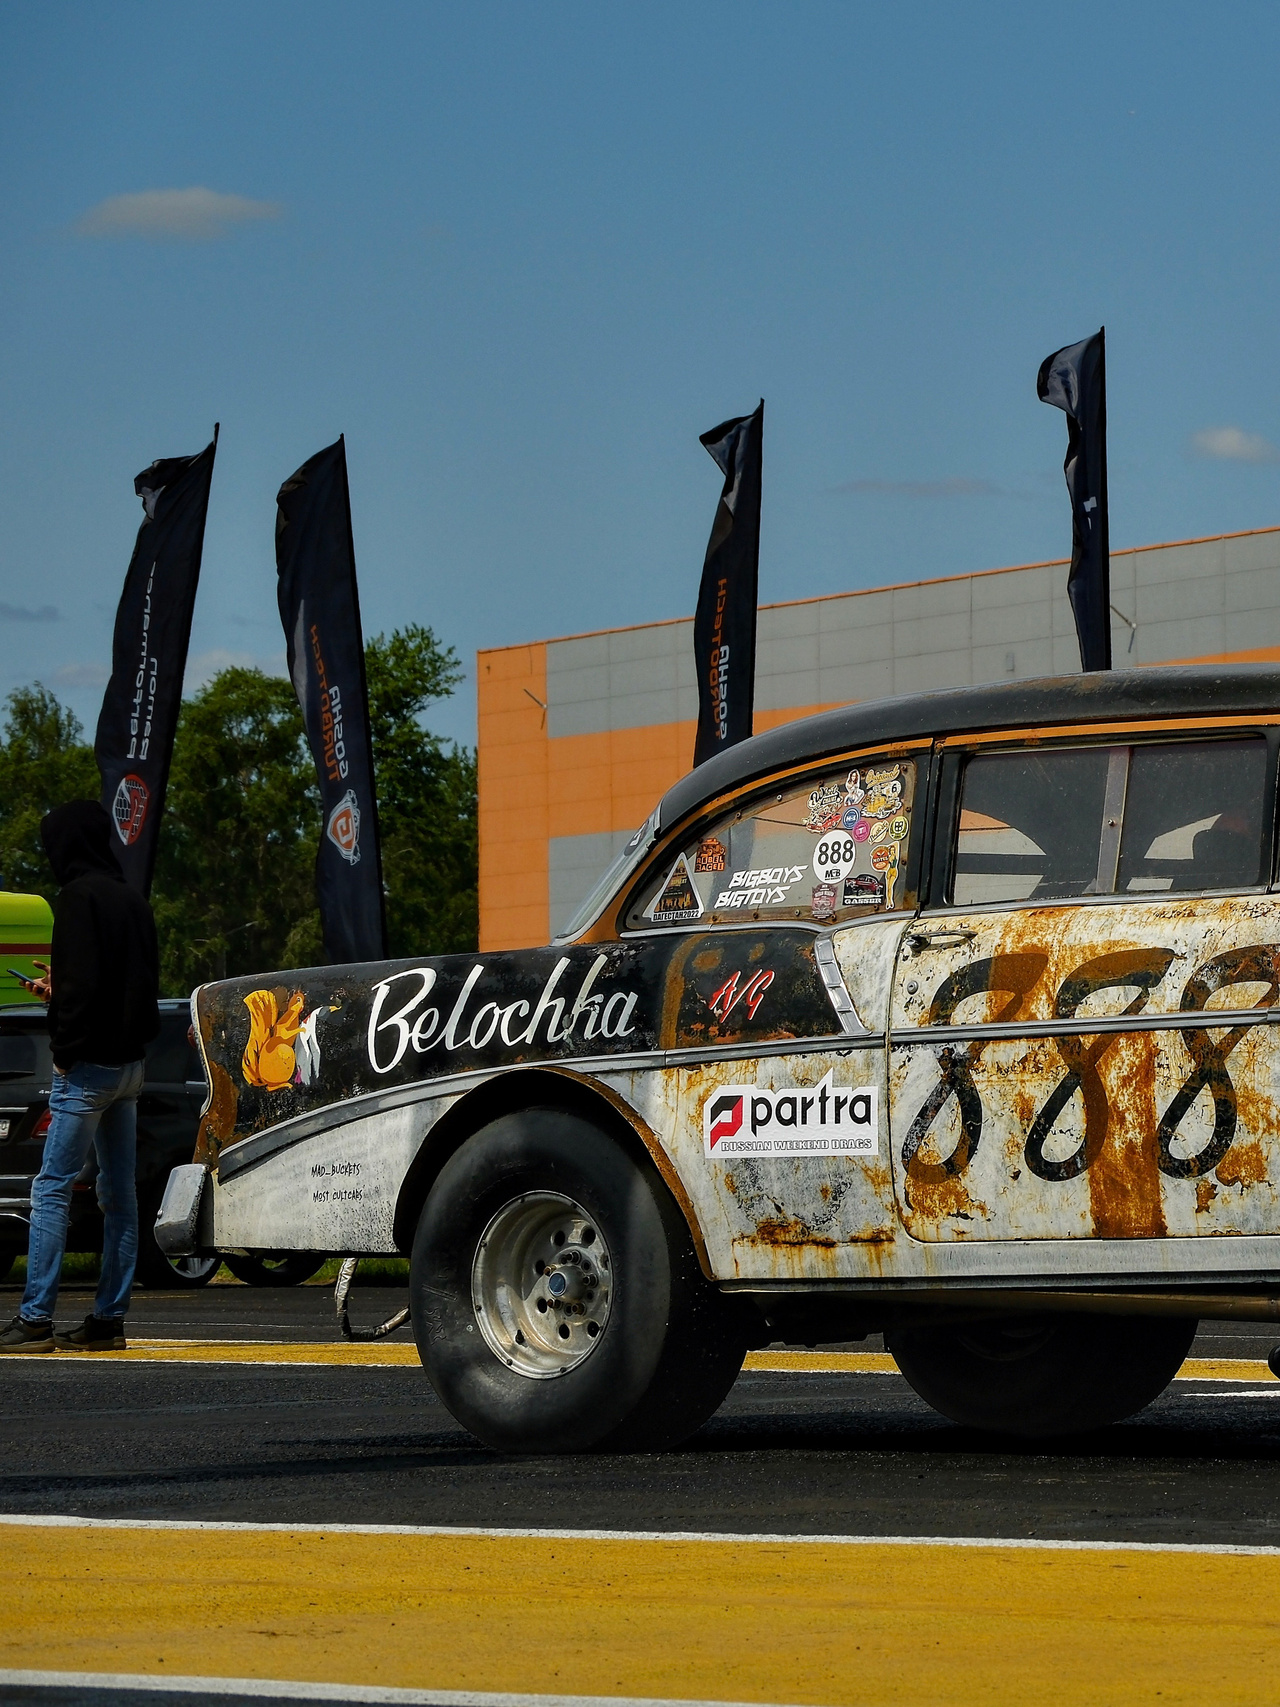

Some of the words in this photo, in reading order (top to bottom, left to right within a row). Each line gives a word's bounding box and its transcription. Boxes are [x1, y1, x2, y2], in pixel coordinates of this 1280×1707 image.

[818, 839, 854, 866] 888
[728, 864, 808, 889] BIGBOYS
[713, 886, 791, 909] BIGTOYS
[368, 953, 639, 1074] Belochka
[751, 1084, 872, 1138] partra
[721, 1141, 772, 1152] RUSSIAN
[774, 1139, 829, 1151] WEEKEND
[831, 1138, 873, 1150] DRAGS
[311, 1161, 361, 1178] MAD_BUCKETS
